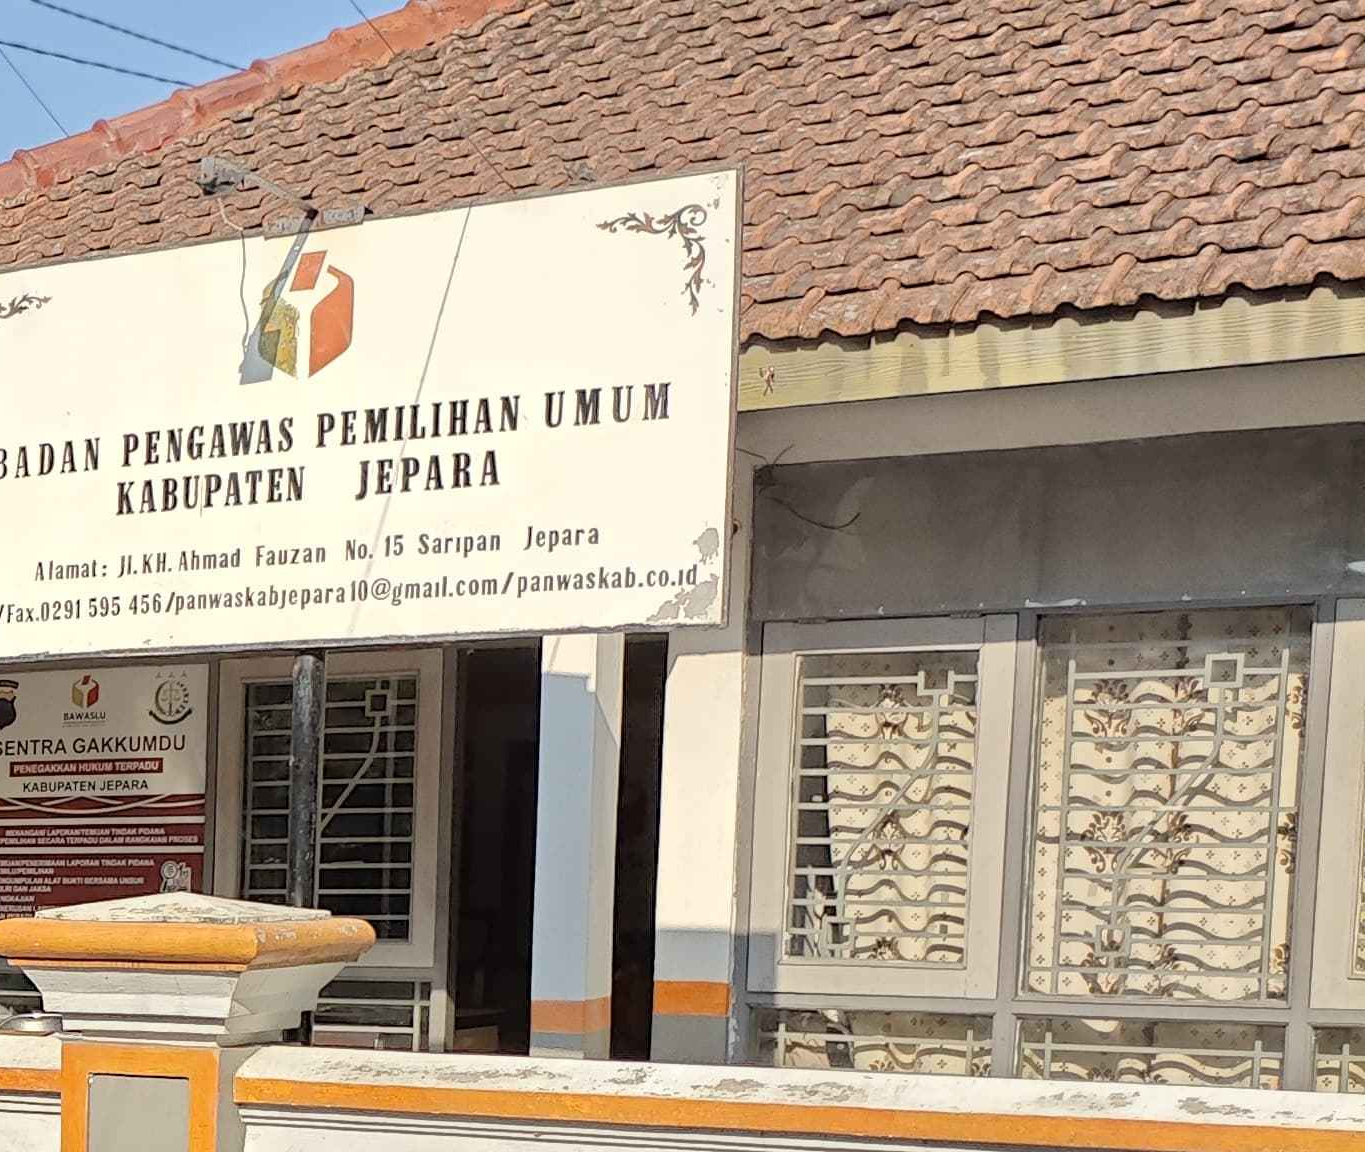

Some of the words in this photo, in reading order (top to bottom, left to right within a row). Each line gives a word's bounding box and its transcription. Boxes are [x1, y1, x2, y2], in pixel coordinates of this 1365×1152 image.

[121, 416, 294, 468] PENGAWAS
[315, 394, 521, 449] PEMILIHAN
[544, 382, 671, 429] UMUM
[116, 465, 305, 516] KABUPATEN
[355, 449, 501, 501] JEPARA
[35, 559, 108, 582] Alamat:
[255, 545, 326, 568] Fauzan
[345, 539, 374, 561] No.
[385, 533, 404, 557] 15
[524, 525, 599, 553] Jepara
[88, 595, 121, 619] 595
[63, 711, 106, 721] BAWASLU
[72, 734, 186, 754] GAKKUMDU
[13, 761, 77, 775] PENEGAKKAN
[78, 760, 113, 773] HUKUM
[114, 759, 160, 772] TERPADU
[23, 780, 96, 793] KABUPATEN
[100, 779, 149, 792] JEPARA
